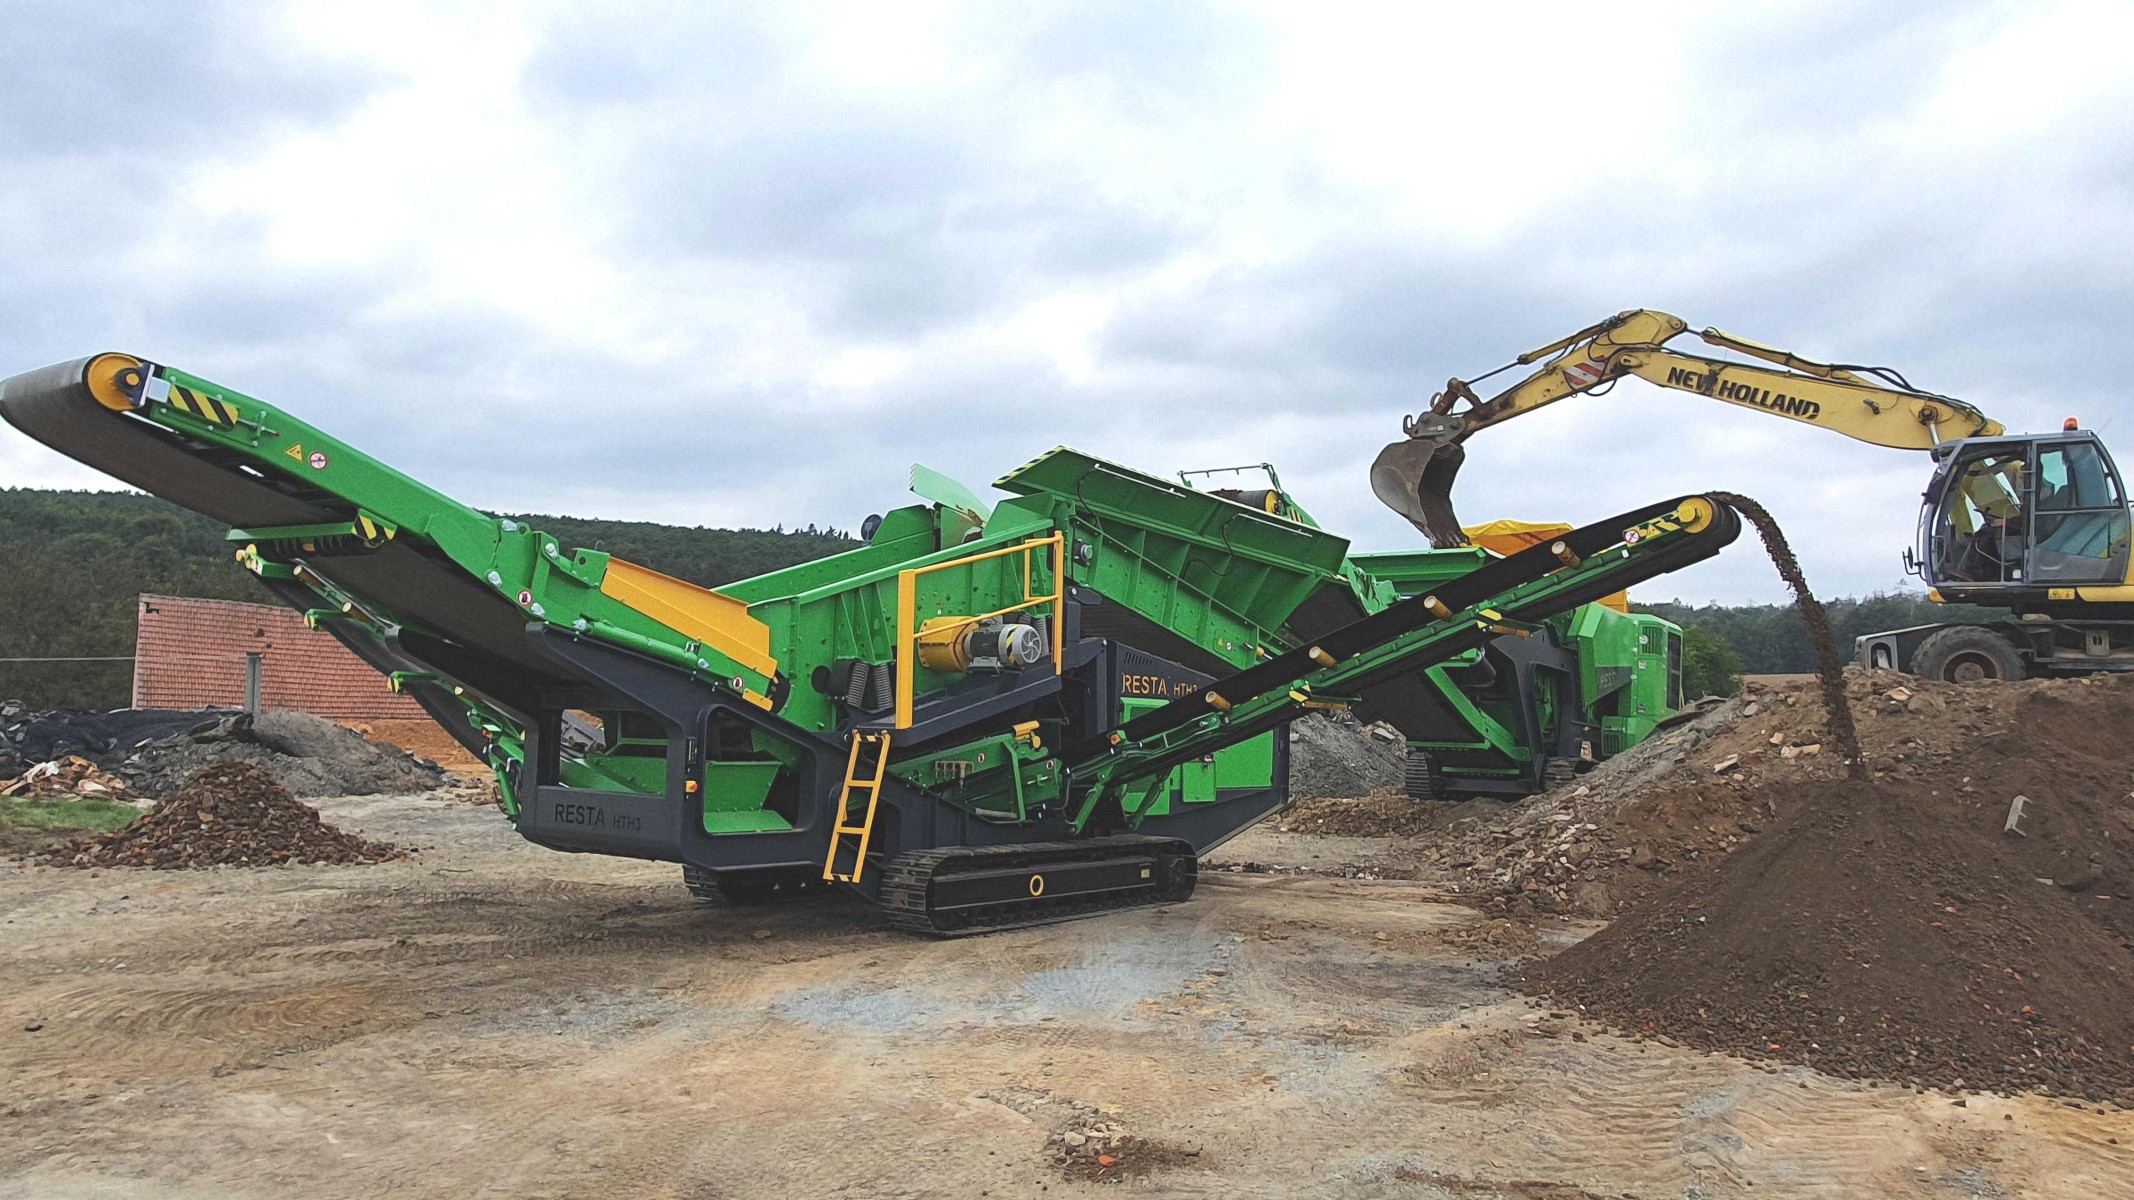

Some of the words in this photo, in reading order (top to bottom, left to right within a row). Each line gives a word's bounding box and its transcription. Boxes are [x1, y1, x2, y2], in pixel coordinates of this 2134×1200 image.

[1718, 380, 1821, 420] HOLLAND
[1122, 674, 1167, 695] RESTA
[554, 803, 606, 827] RESTA
[612, 815, 641, 831] HTH3
